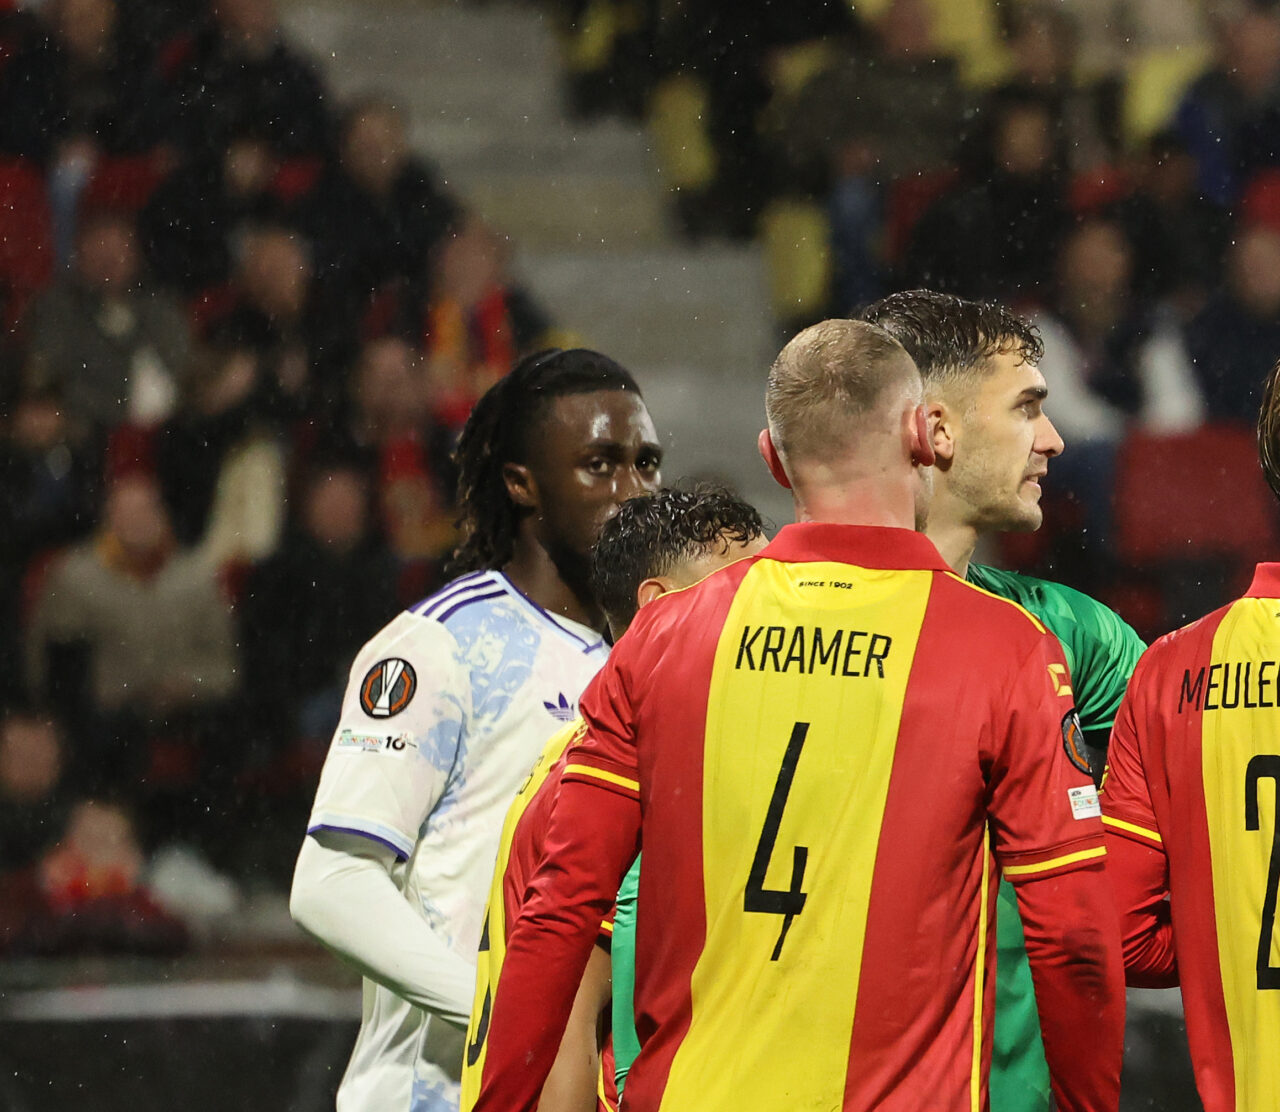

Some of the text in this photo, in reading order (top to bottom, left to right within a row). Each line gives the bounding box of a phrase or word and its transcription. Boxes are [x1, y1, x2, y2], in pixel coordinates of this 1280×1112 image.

[829, 581, 853, 590] 1902
[735, 625, 893, 679] KRAMER
[743, 721, 811, 962] 4
